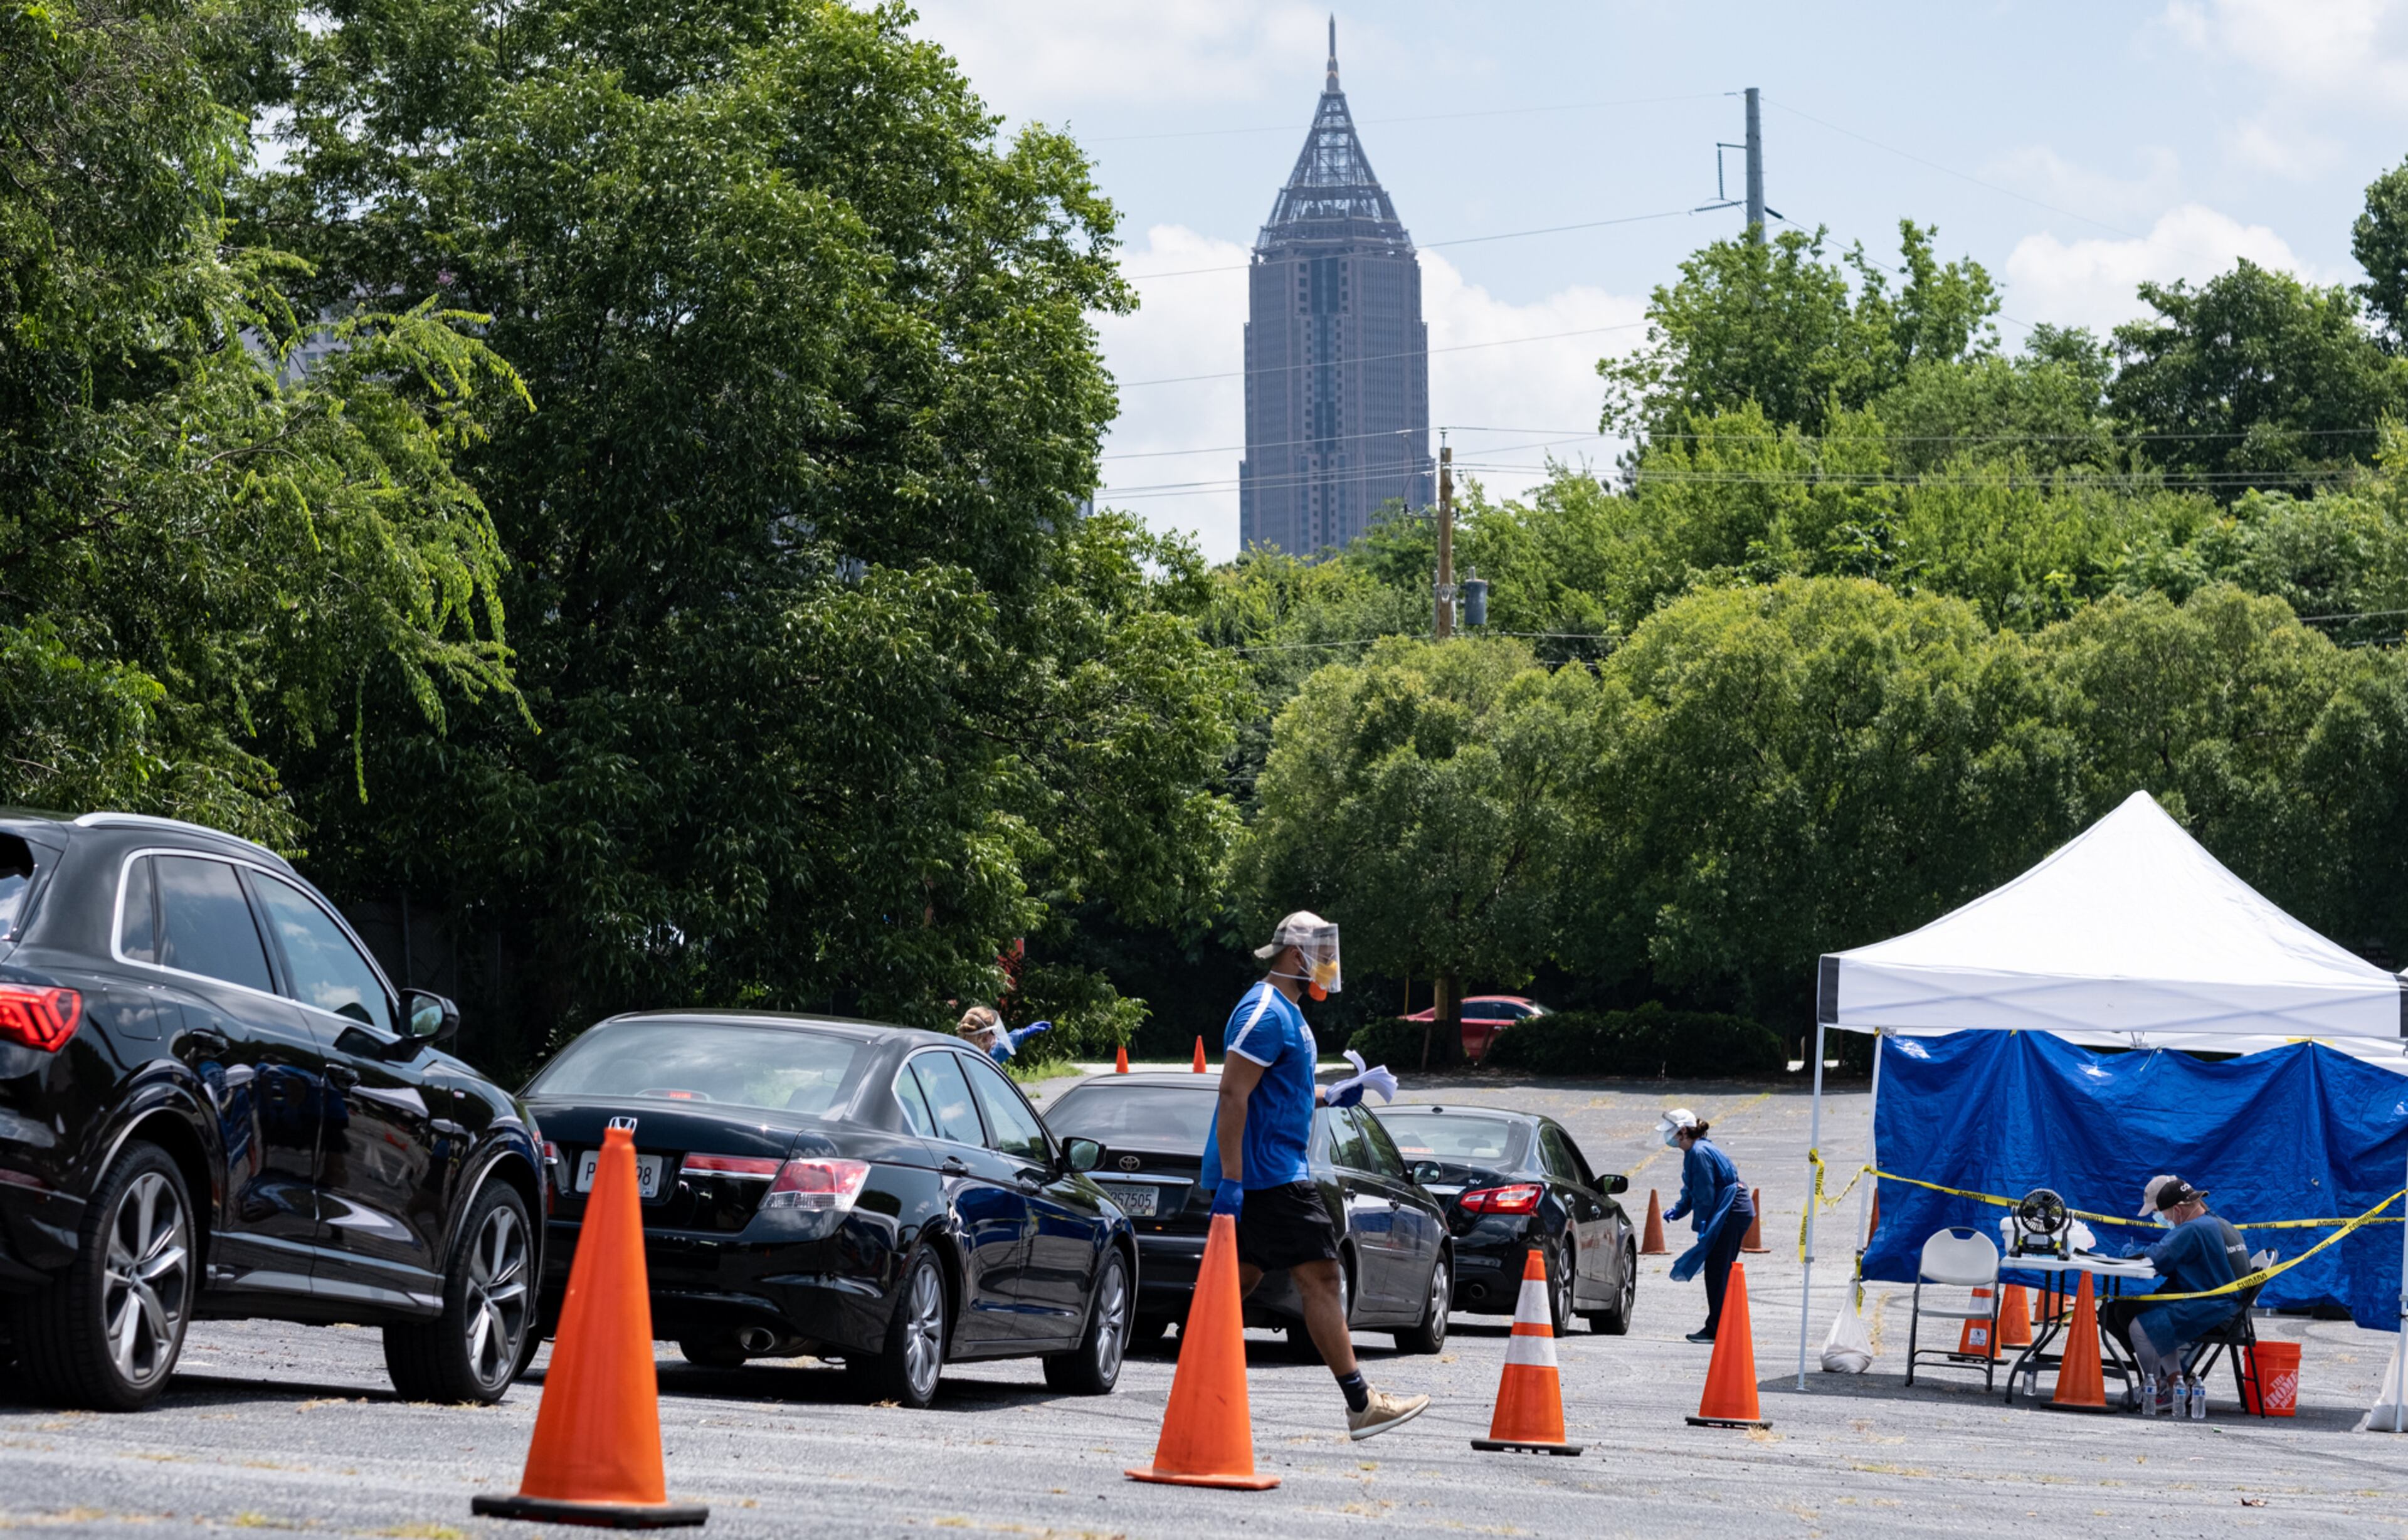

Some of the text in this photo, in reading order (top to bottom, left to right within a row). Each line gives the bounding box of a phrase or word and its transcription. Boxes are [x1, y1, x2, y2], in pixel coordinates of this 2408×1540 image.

[1108, 1191, 1152, 1208] S7505
[2265, 1369, 2298, 1408] HOME
[2269, 1373, 2287, 1389] THE
